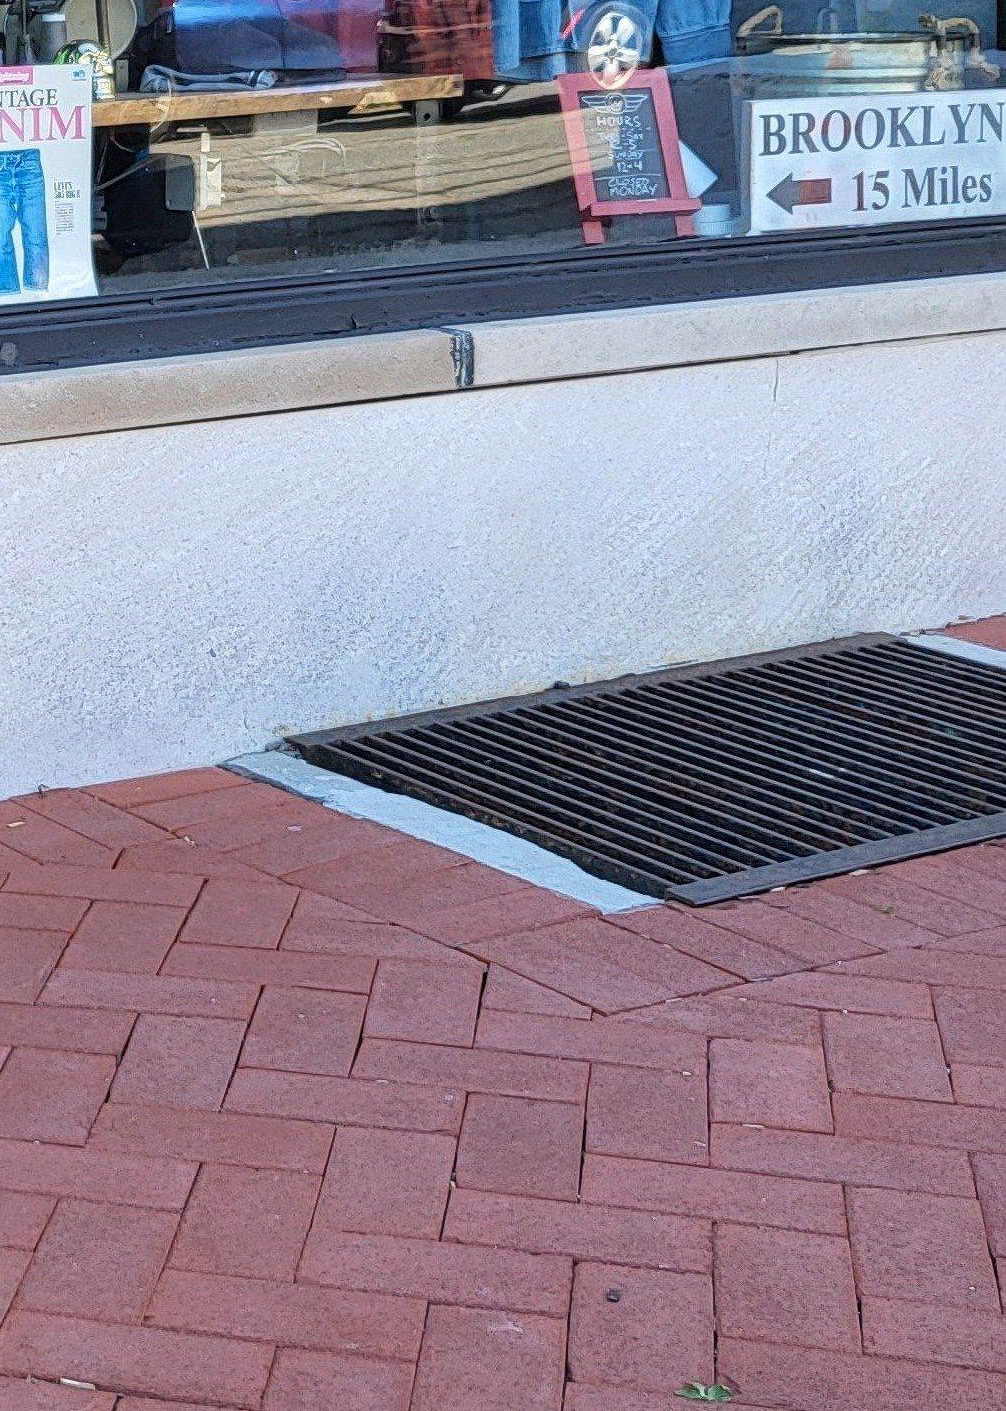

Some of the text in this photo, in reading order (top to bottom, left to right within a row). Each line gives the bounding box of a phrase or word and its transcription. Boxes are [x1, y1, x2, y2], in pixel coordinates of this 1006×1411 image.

[596, 114, 641, 128] HOURS
[759, 101, 1006, 156] BROOKLYN
[607, 176, 650, 187] CLOSED
[851, 165, 992, 212] 15 Miles
[609, 183, 658, 197] MONDAY
